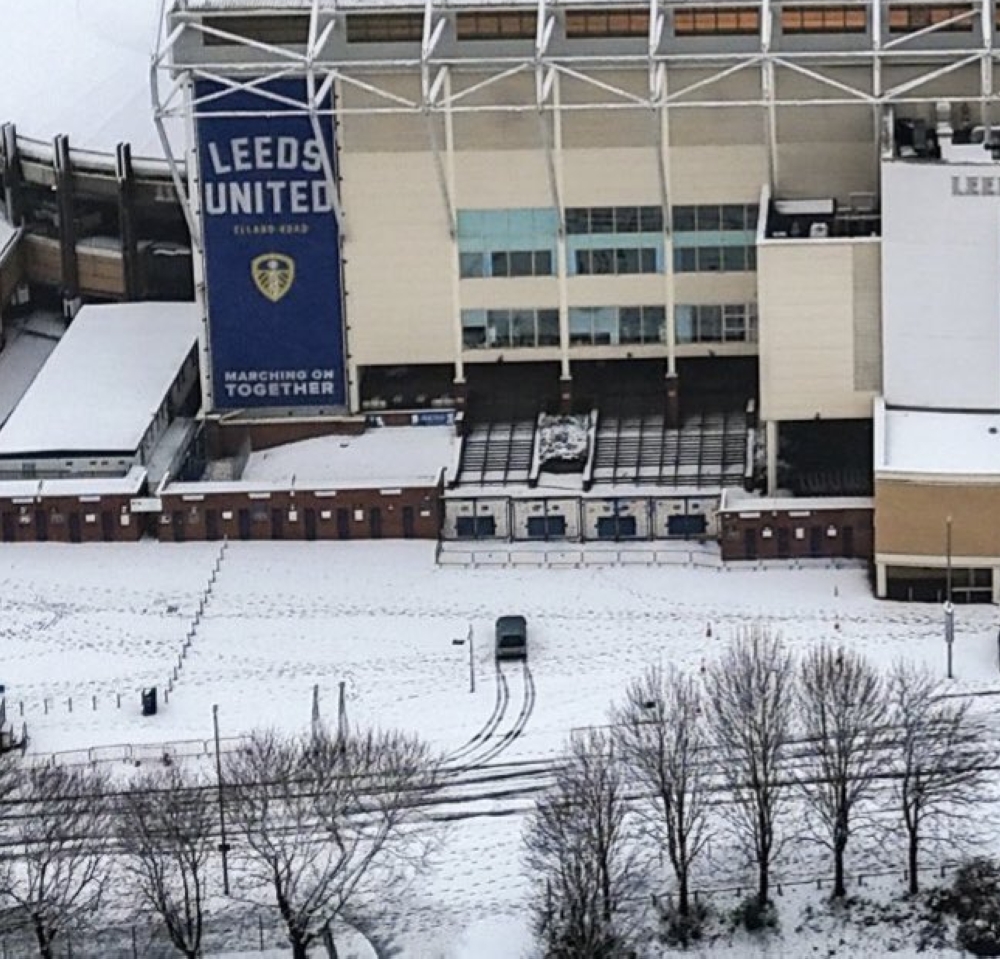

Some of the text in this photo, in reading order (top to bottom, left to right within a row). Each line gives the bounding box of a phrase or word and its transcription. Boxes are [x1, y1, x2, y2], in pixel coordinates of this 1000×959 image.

[208, 136, 325, 175] LEEDS
[205, 179, 335, 215] UNITED
[225, 369, 334, 382] MARCHING ON
[225, 382, 334, 397] TOGETHER
